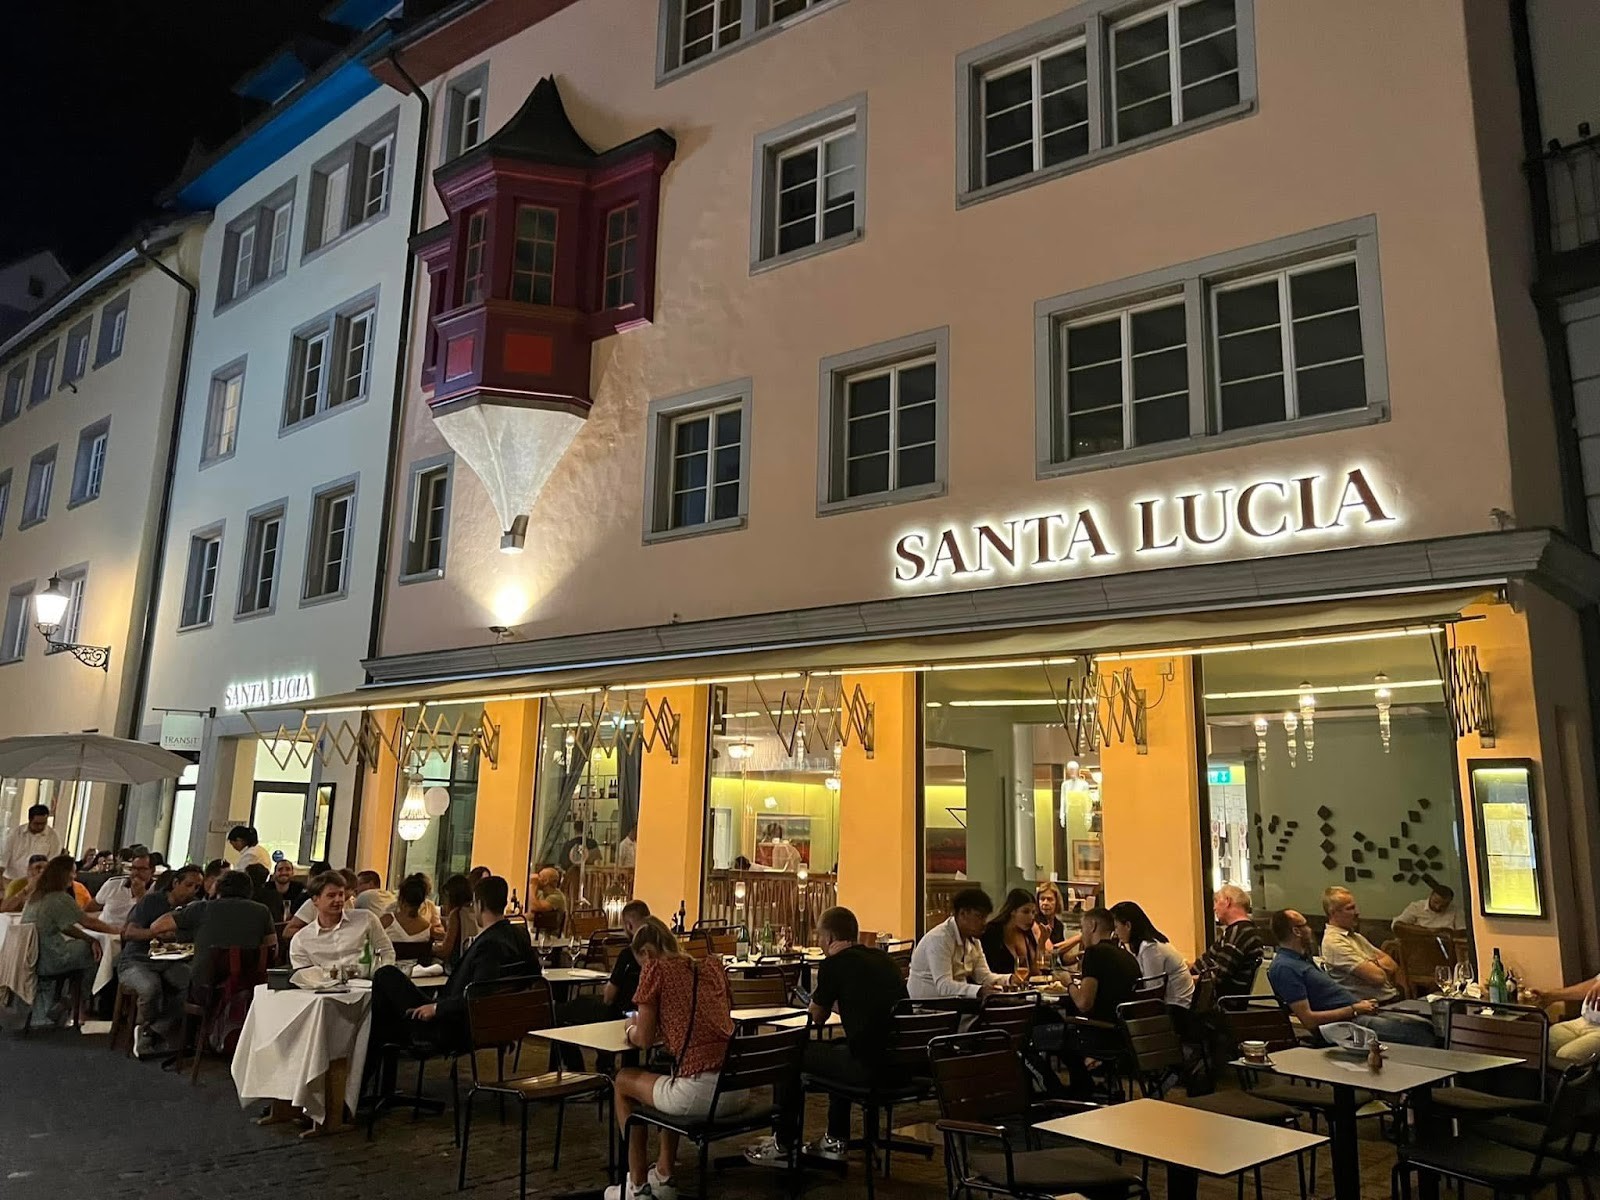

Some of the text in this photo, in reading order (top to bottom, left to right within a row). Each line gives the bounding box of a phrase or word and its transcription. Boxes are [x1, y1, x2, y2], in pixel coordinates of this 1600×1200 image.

[894, 467, 1397, 582] SANTA LUCIA
[225, 676, 310, 706] SANTA LUCIA
